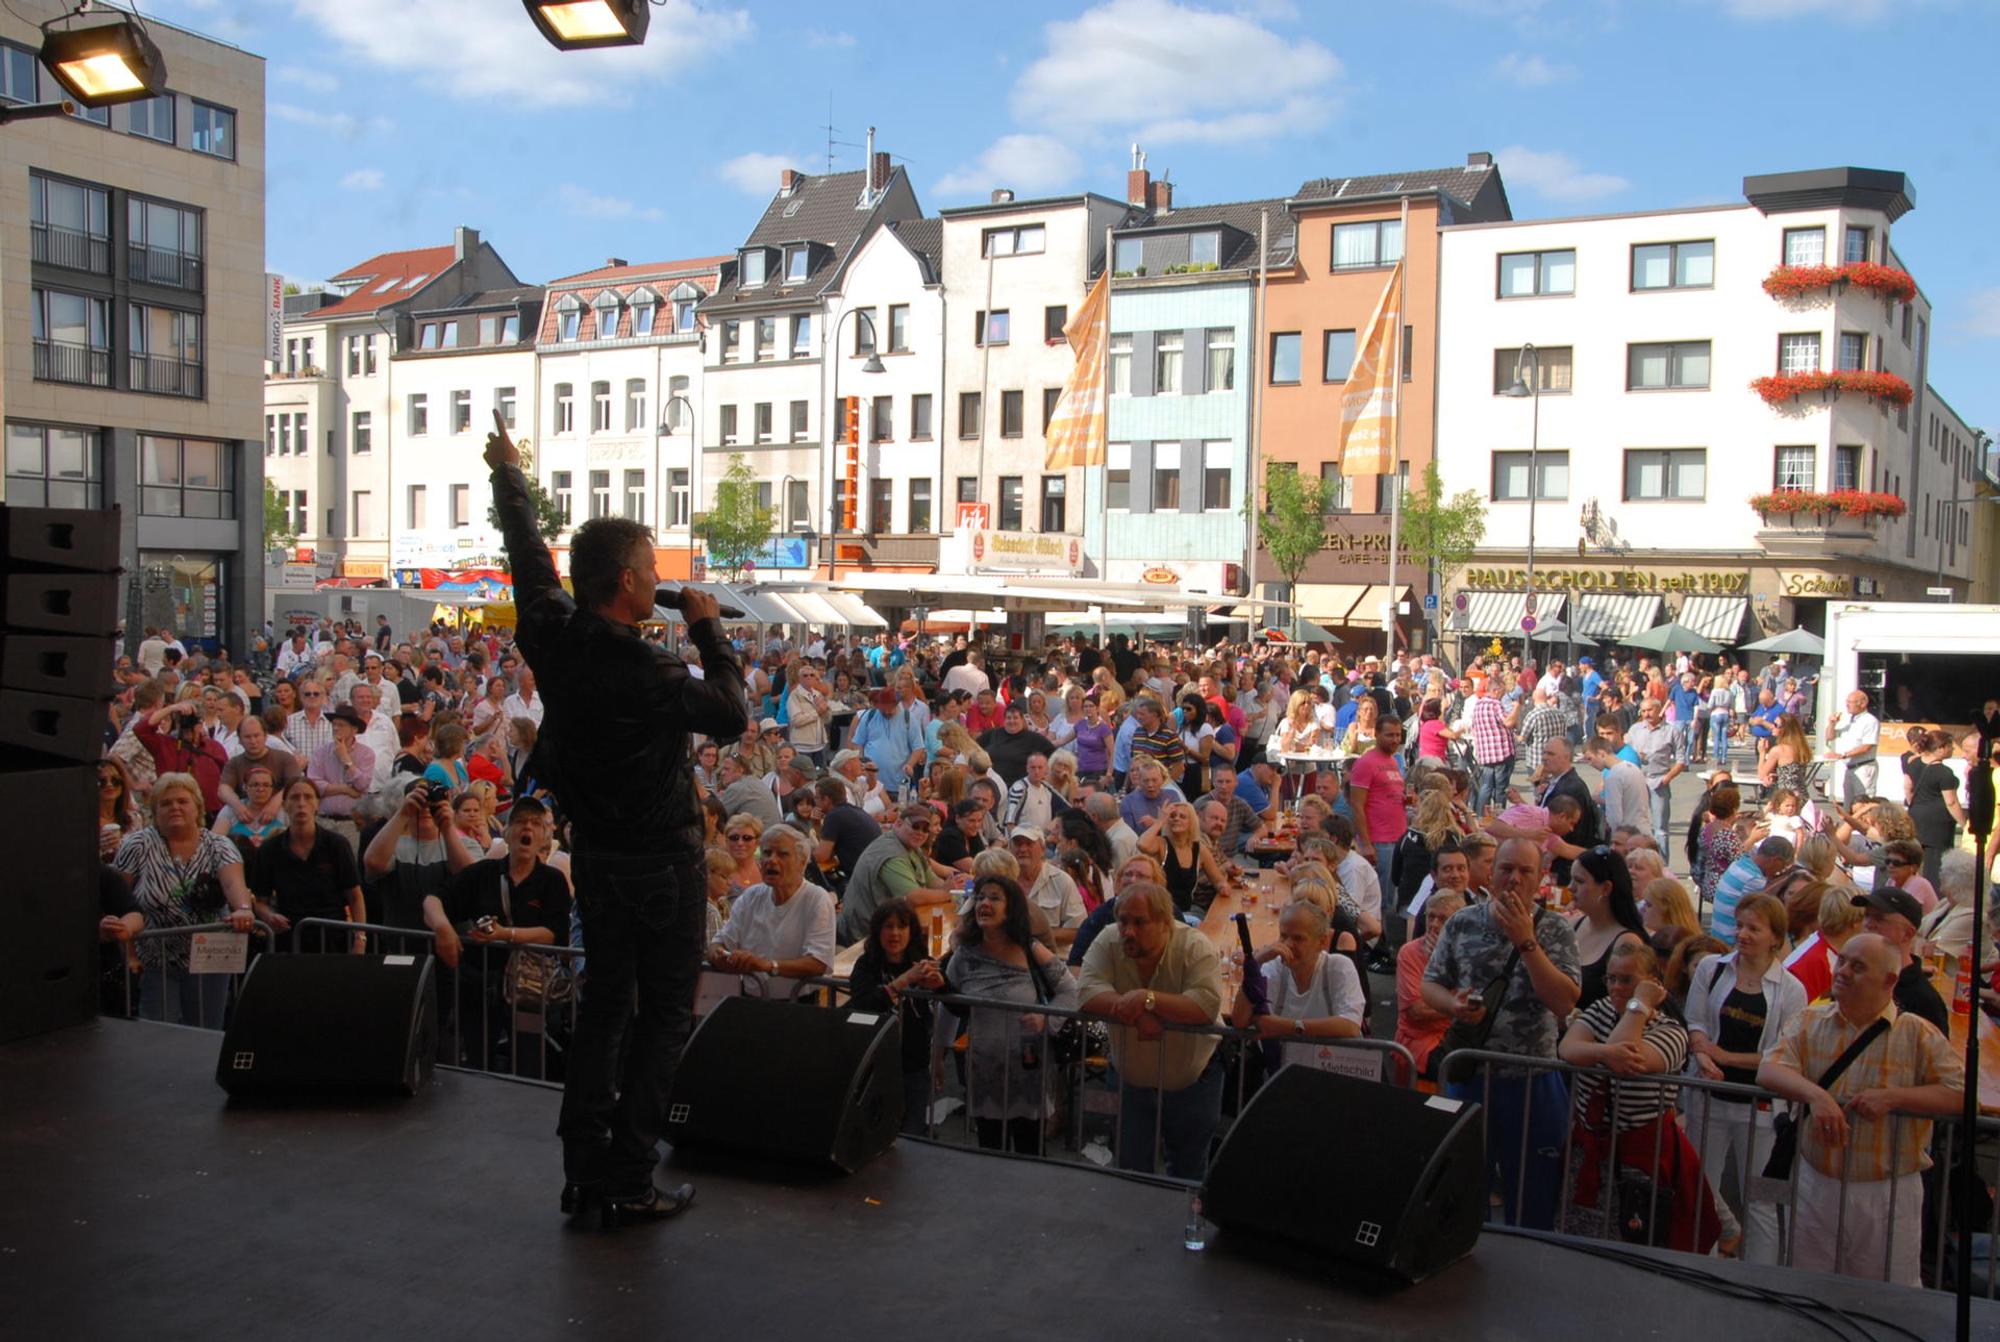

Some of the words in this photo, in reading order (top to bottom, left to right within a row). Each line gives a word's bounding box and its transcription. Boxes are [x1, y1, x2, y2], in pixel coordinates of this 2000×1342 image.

[272, 277, 281, 309] BANK
[272, 321, 281, 357] TARGO
[1466, 568, 1526, 588] HAUS
[1660, 571, 1694, 590] seit
[1698, 571, 1747, 591] 1907
